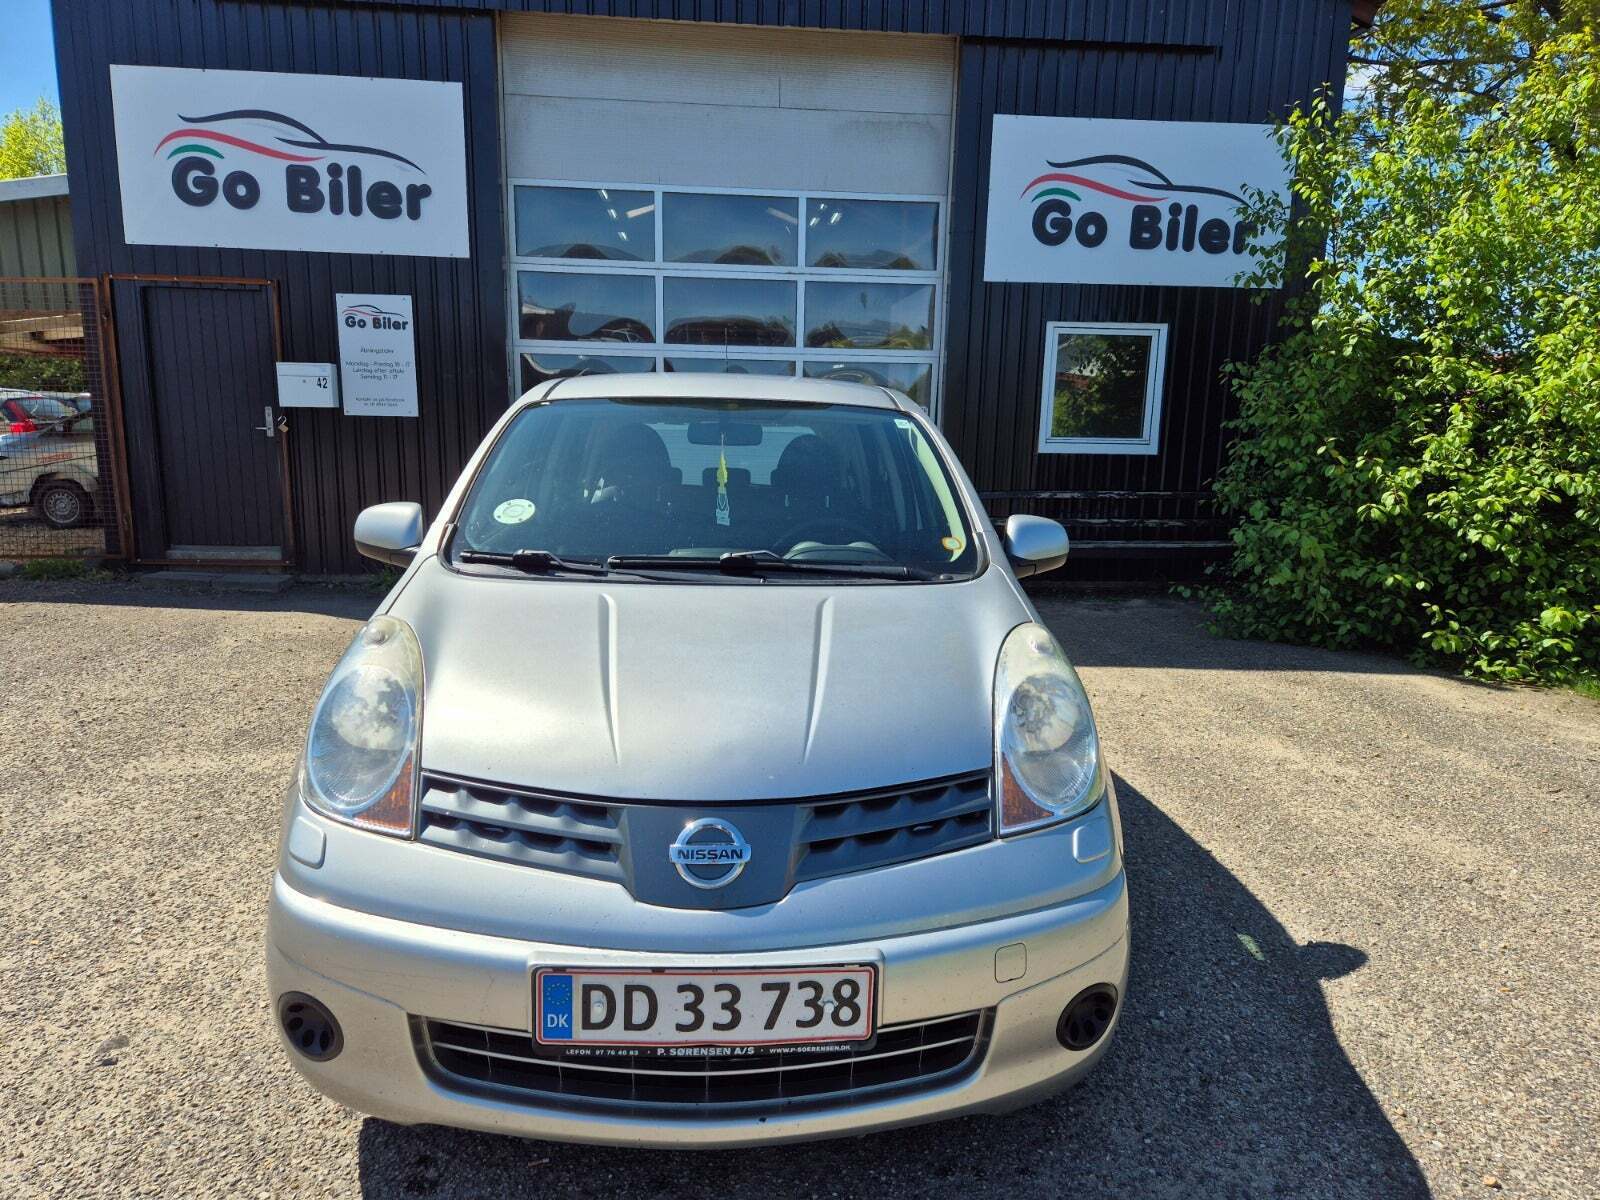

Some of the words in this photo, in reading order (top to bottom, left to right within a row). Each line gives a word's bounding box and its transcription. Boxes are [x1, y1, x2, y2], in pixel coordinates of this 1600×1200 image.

[171, 156, 260, 210] Go
[285, 162, 432, 221] Biler
[1032, 198, 1108, 248] Go
[1129, 202, 1258, 255] Biler
[344, 315, 366, 328] Go
[372, 317, 408, 330] Biler
[317, 377, 328, 389] 42
[677, 849, 743, 860] NISSAN
[581, 983, 658, 1031] DD
[675, 983, 742, 1032] 33
[761, 979, 861, 1031] 738
[547, 1013, 568, 1028] DK
[657, 1048, 666, 1056] P.
[669, 1047, 733, 1056] SØRENSEN
[734, 1046, 754, 1056] A/S
